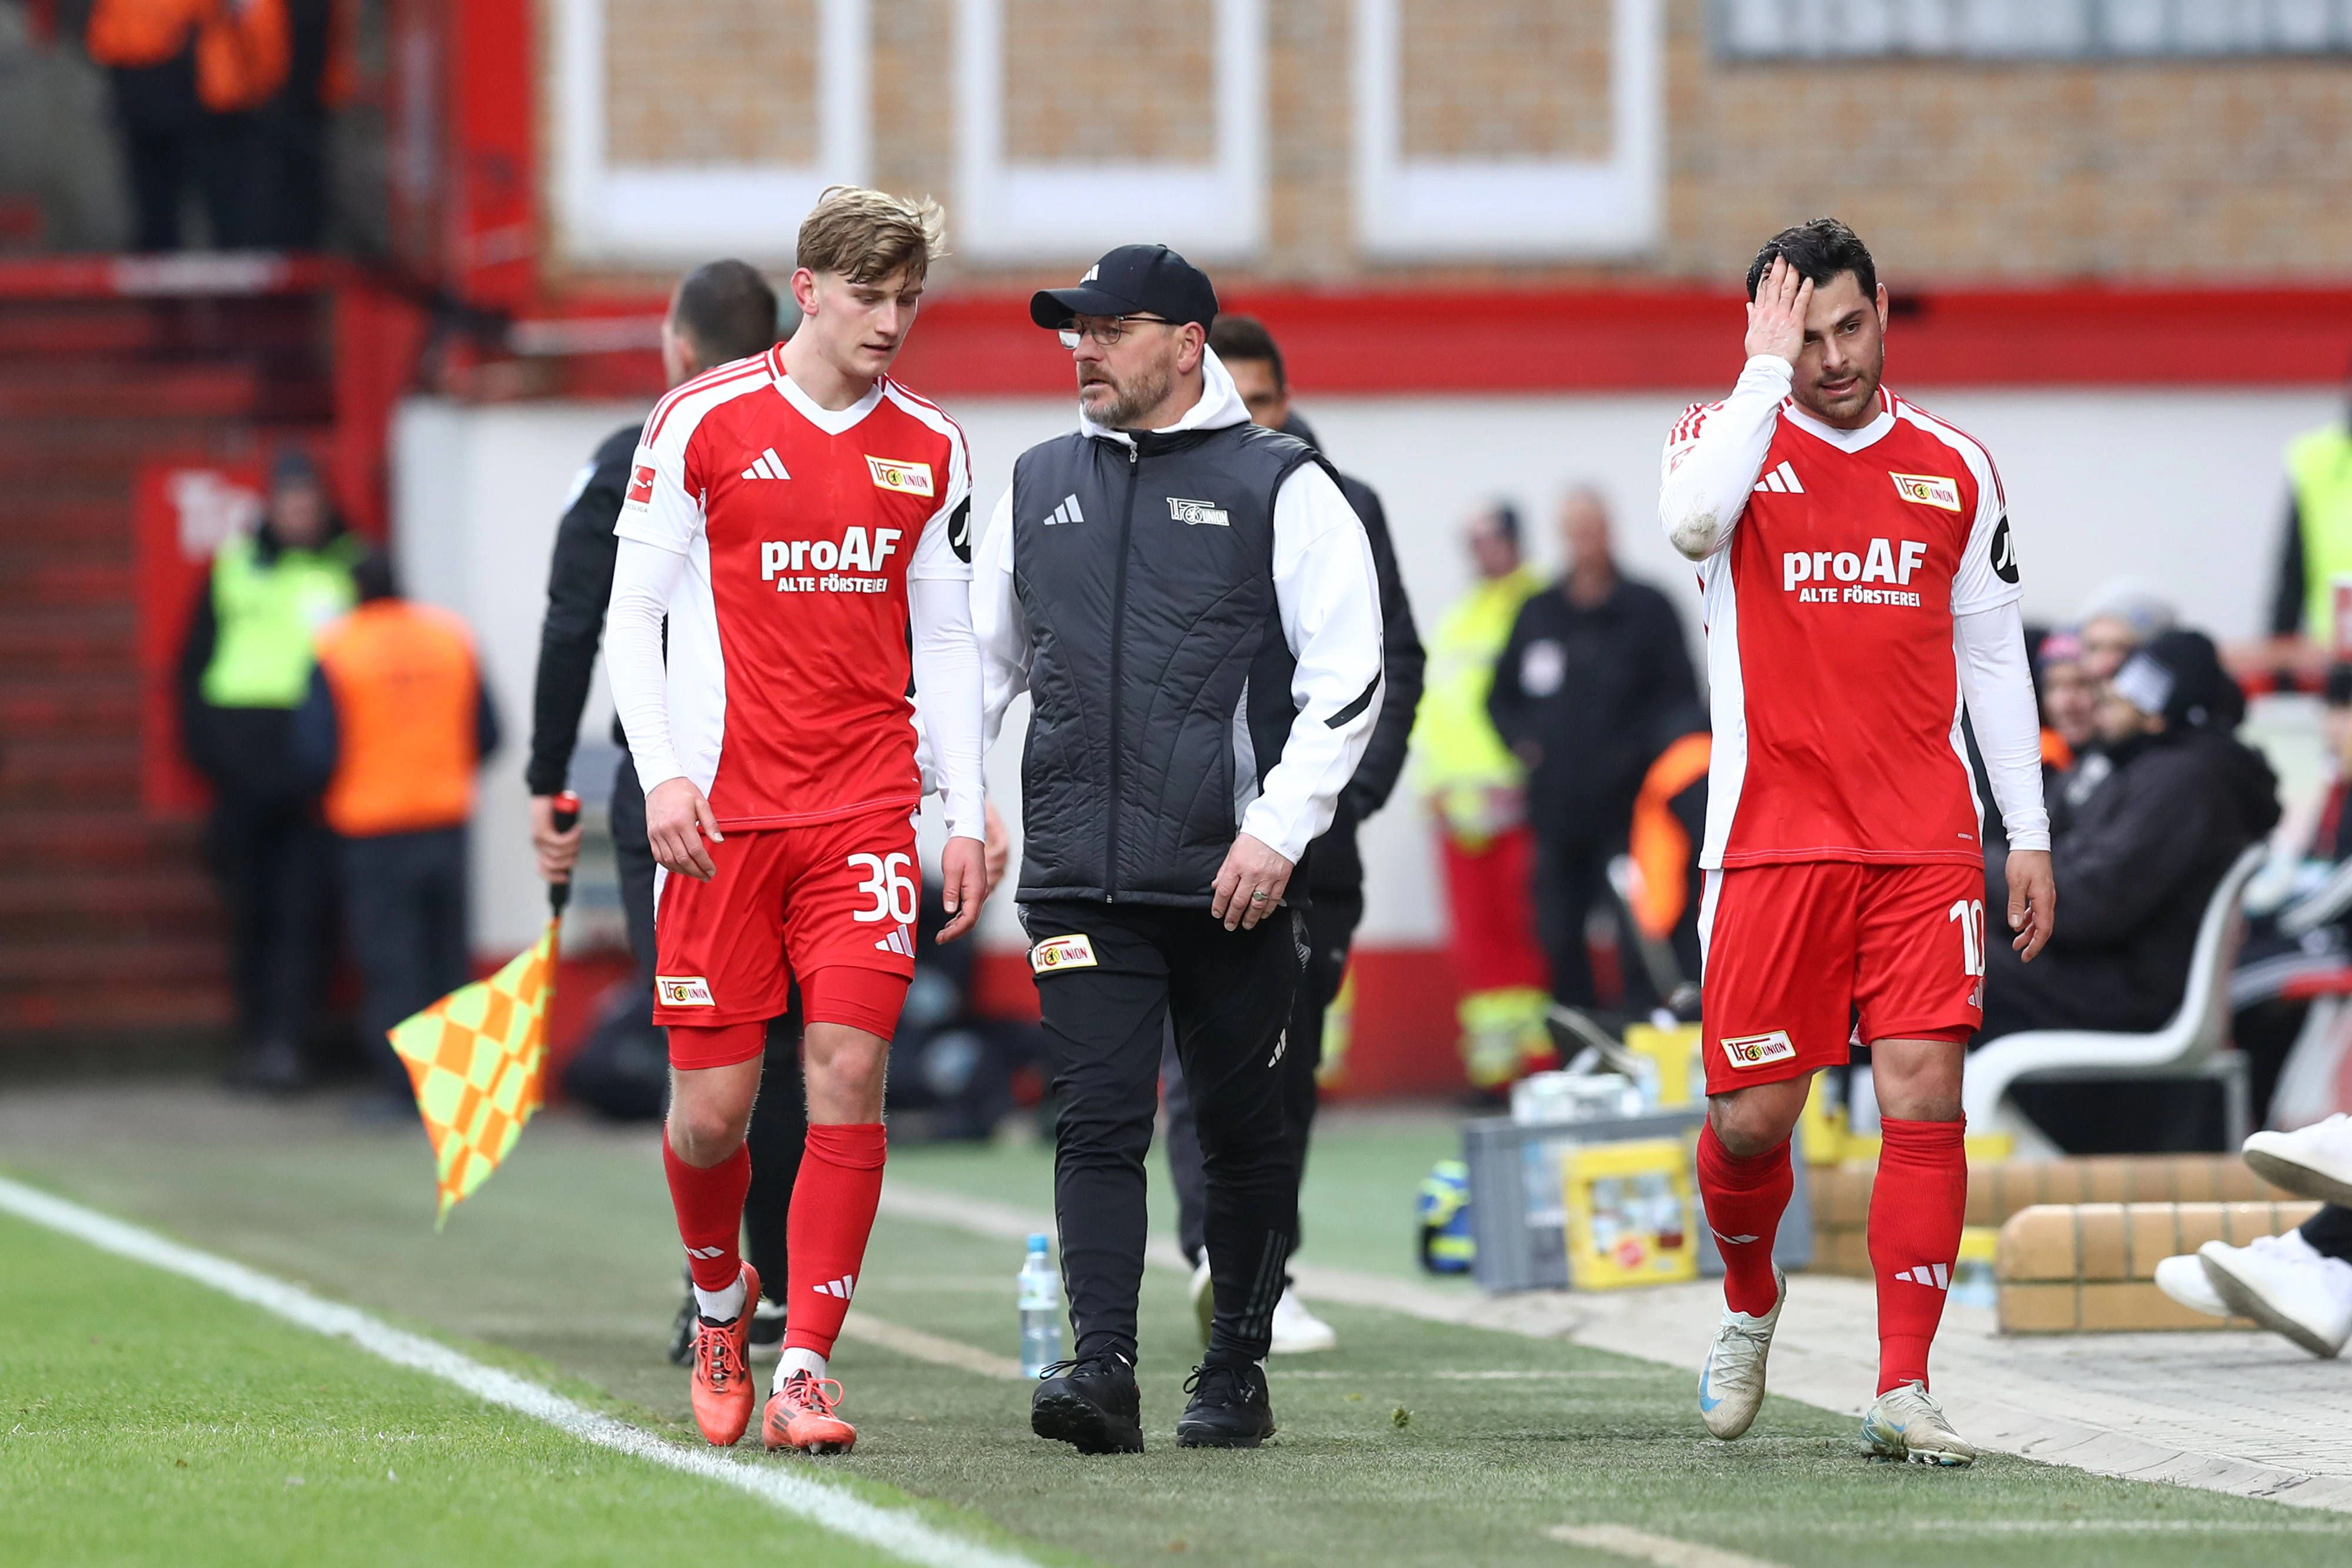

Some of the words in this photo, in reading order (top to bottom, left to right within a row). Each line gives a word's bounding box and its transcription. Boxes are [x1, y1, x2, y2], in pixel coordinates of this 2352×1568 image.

[903, 474, 928, 489] UNION
[1930, 488, 1955, 503] UNION
[1202, 509, 1230, 526] UNION
[761, 526, 902, 581] proAF
[1783, 538, 1927, 591] proAF
[777, 577, 815, 592] ALTE
[1799, 587, 1838, 603] ALTE
[1843, 584, 1920, 607] FÖRSTEREI
[847, 852, 917, 924] 36
[1949, 899, 1986, 977] 10
[1060, 948, 1088, 961] UNION
[688, 988, 709, 999] UNION
[1762, 1042, 1787, 1056] UNION
